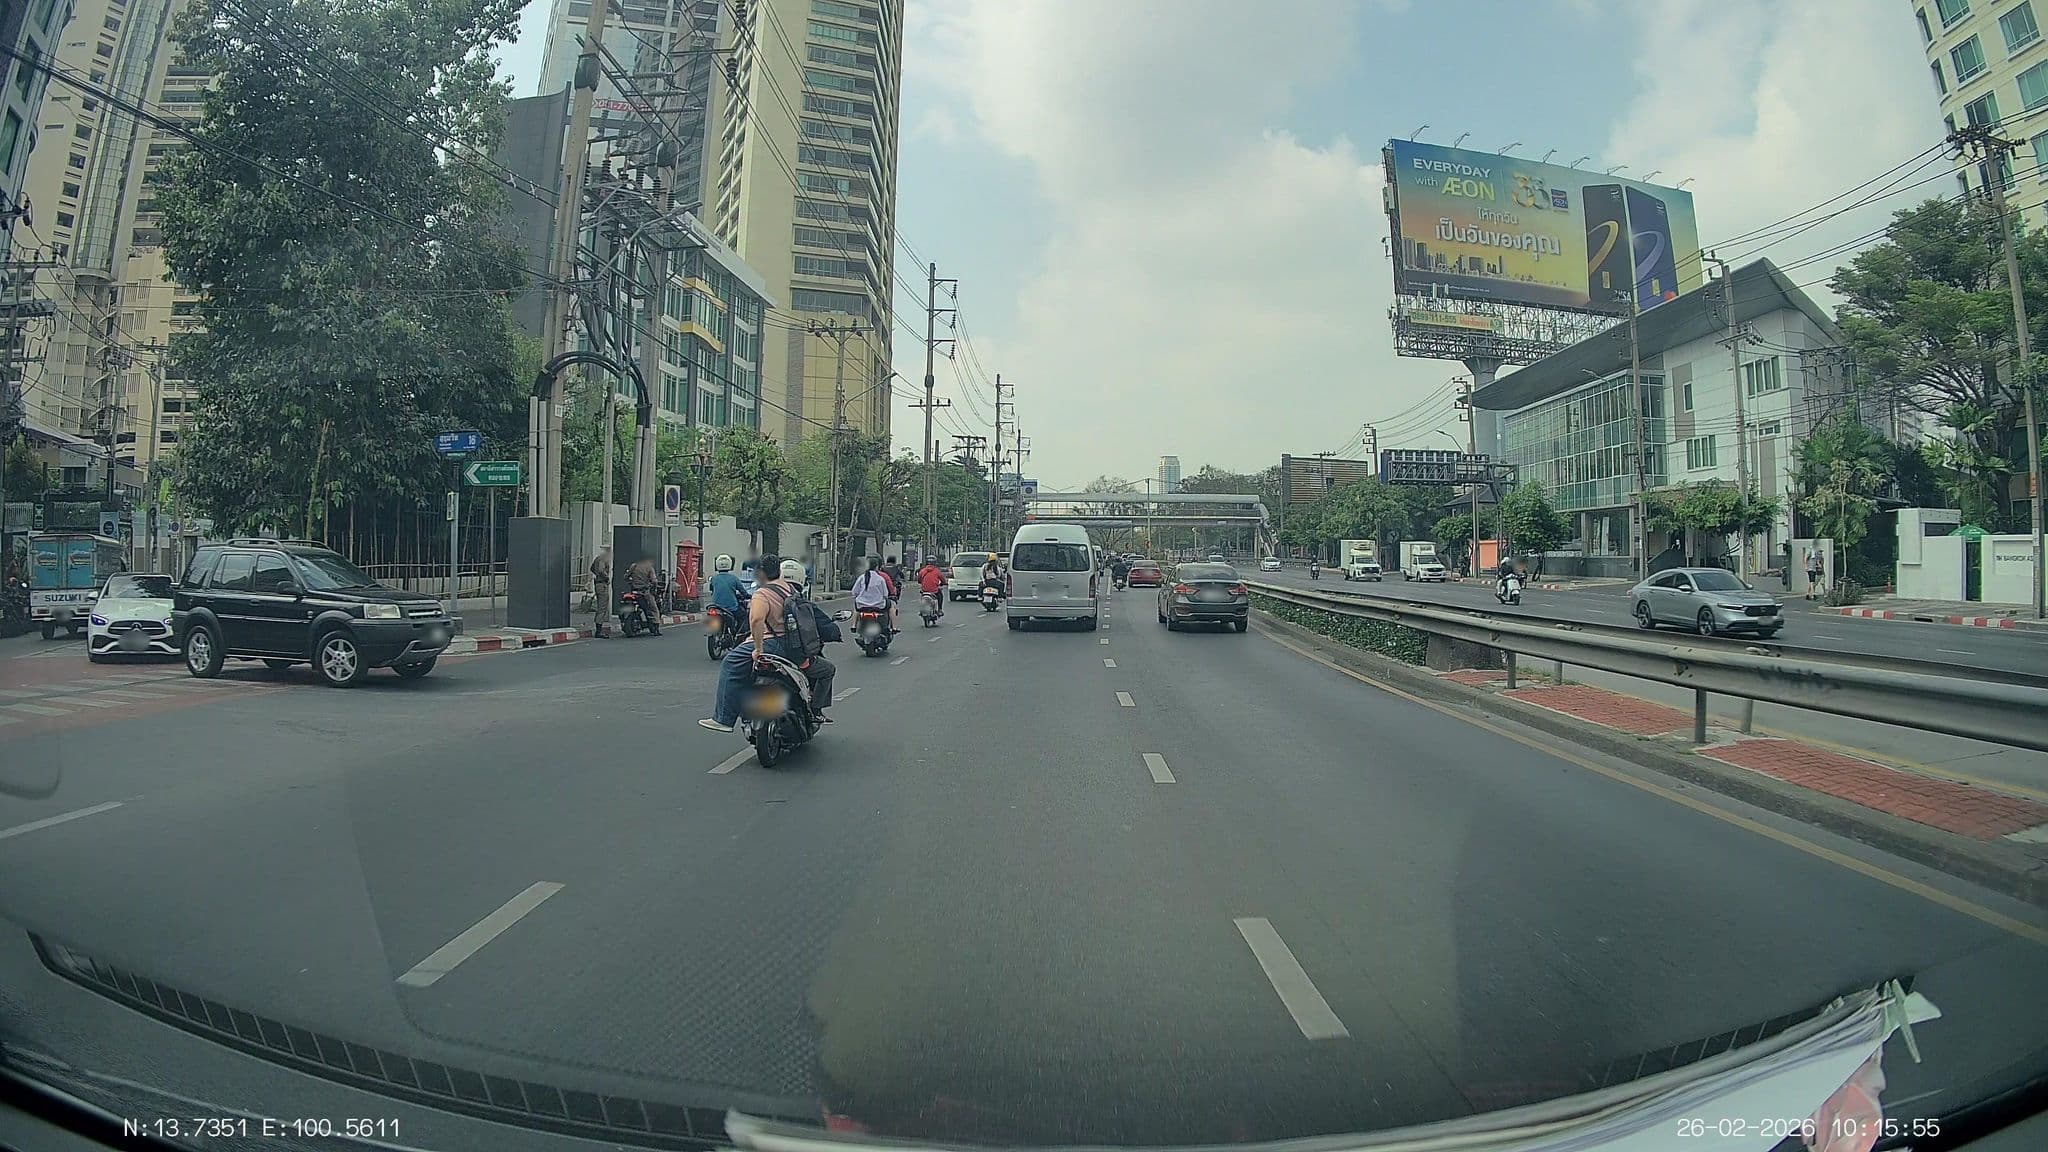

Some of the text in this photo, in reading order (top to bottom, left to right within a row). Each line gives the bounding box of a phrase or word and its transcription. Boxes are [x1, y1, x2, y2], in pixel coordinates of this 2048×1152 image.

[1412, 158, 1491, 179] EVERYDAY
[1415, 176, 1438, 187] with
[1435, 217, 1560, 262] เป็นวันของคุณ
[44, 594, 82, 602] SUZUKI
